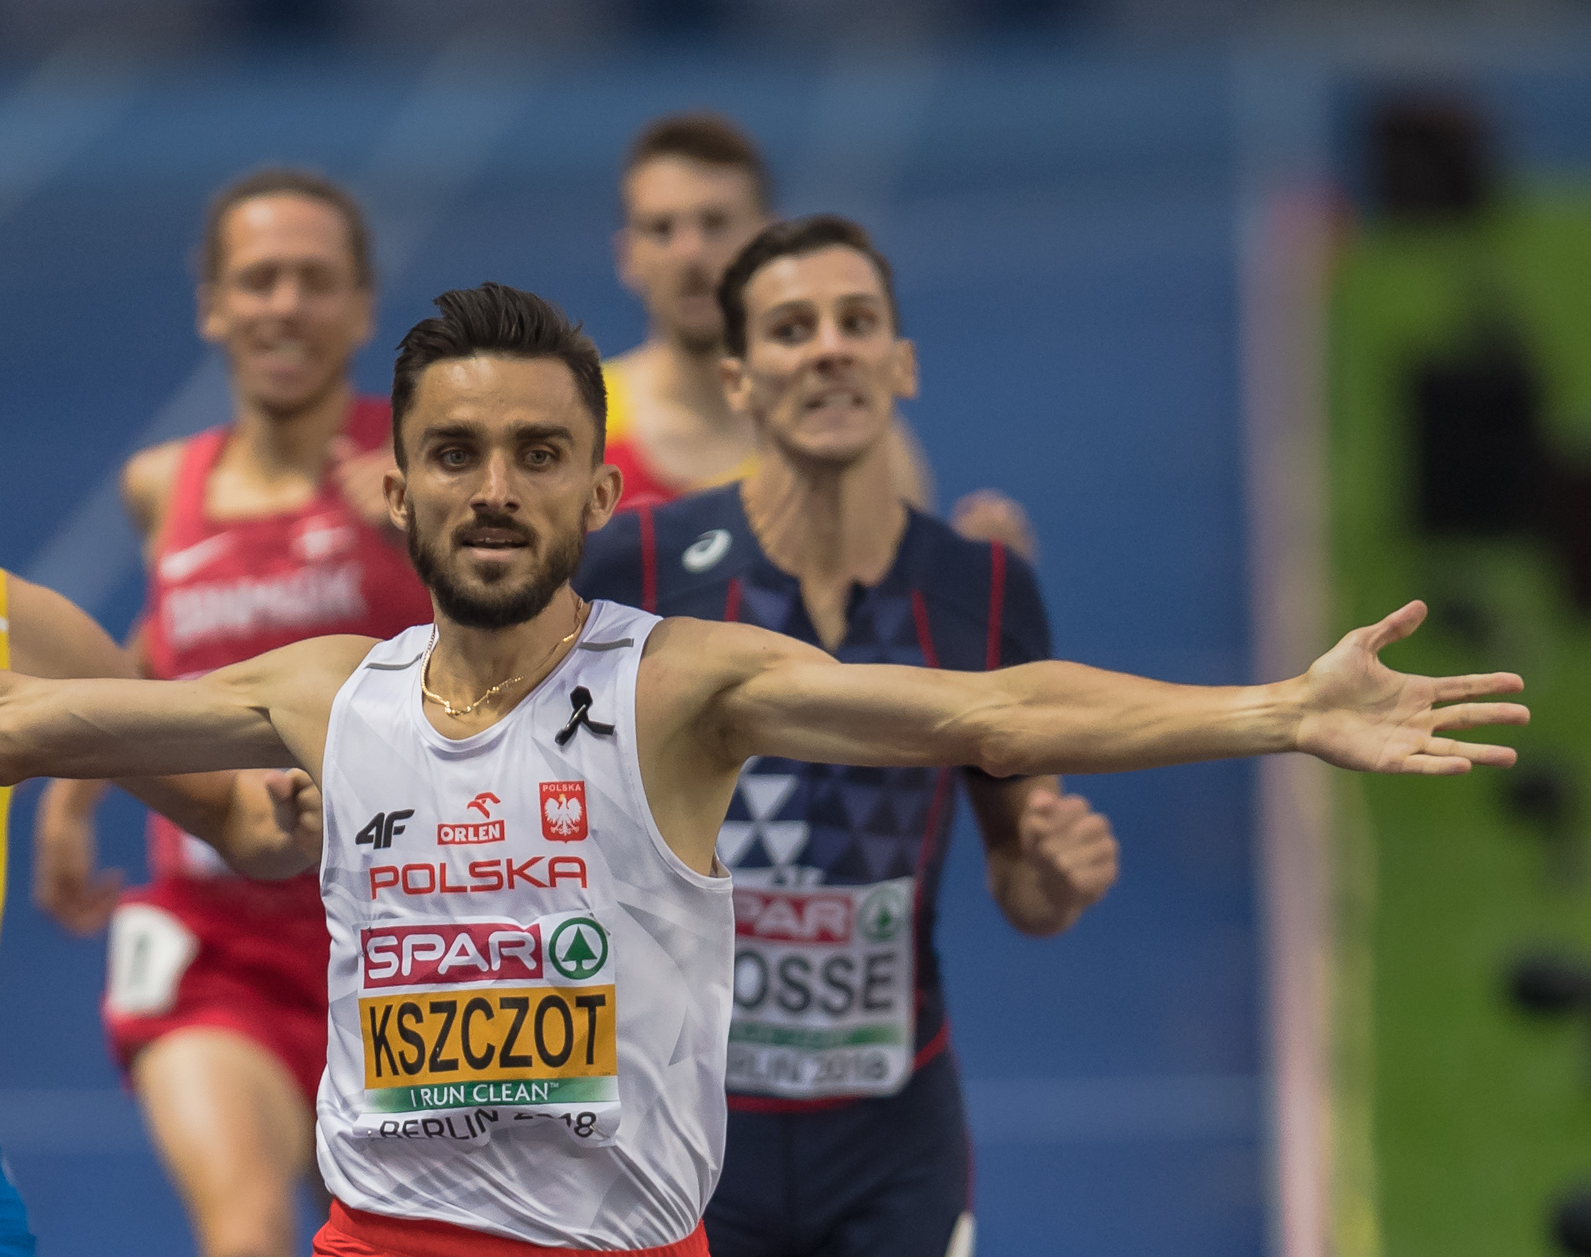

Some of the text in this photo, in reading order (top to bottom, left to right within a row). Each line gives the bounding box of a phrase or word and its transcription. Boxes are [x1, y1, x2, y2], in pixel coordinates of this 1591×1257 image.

[542, 783, 582, 792] POLSKA
[355, 808, 416, 850] 4F
[440, 823, 501, 842] ORLEN
[369, 855, 588, 900] POLSKA
[734, 895, 850, 941] PAR
[367, 931, 538, 980] SPAR
[734, 950, 896, 1016] OSSE
[369, 993, 607, 1079] KSZCZOT
[410, 1089, 417, 1108] I
[420, 1085, 465, 1106] RUN
